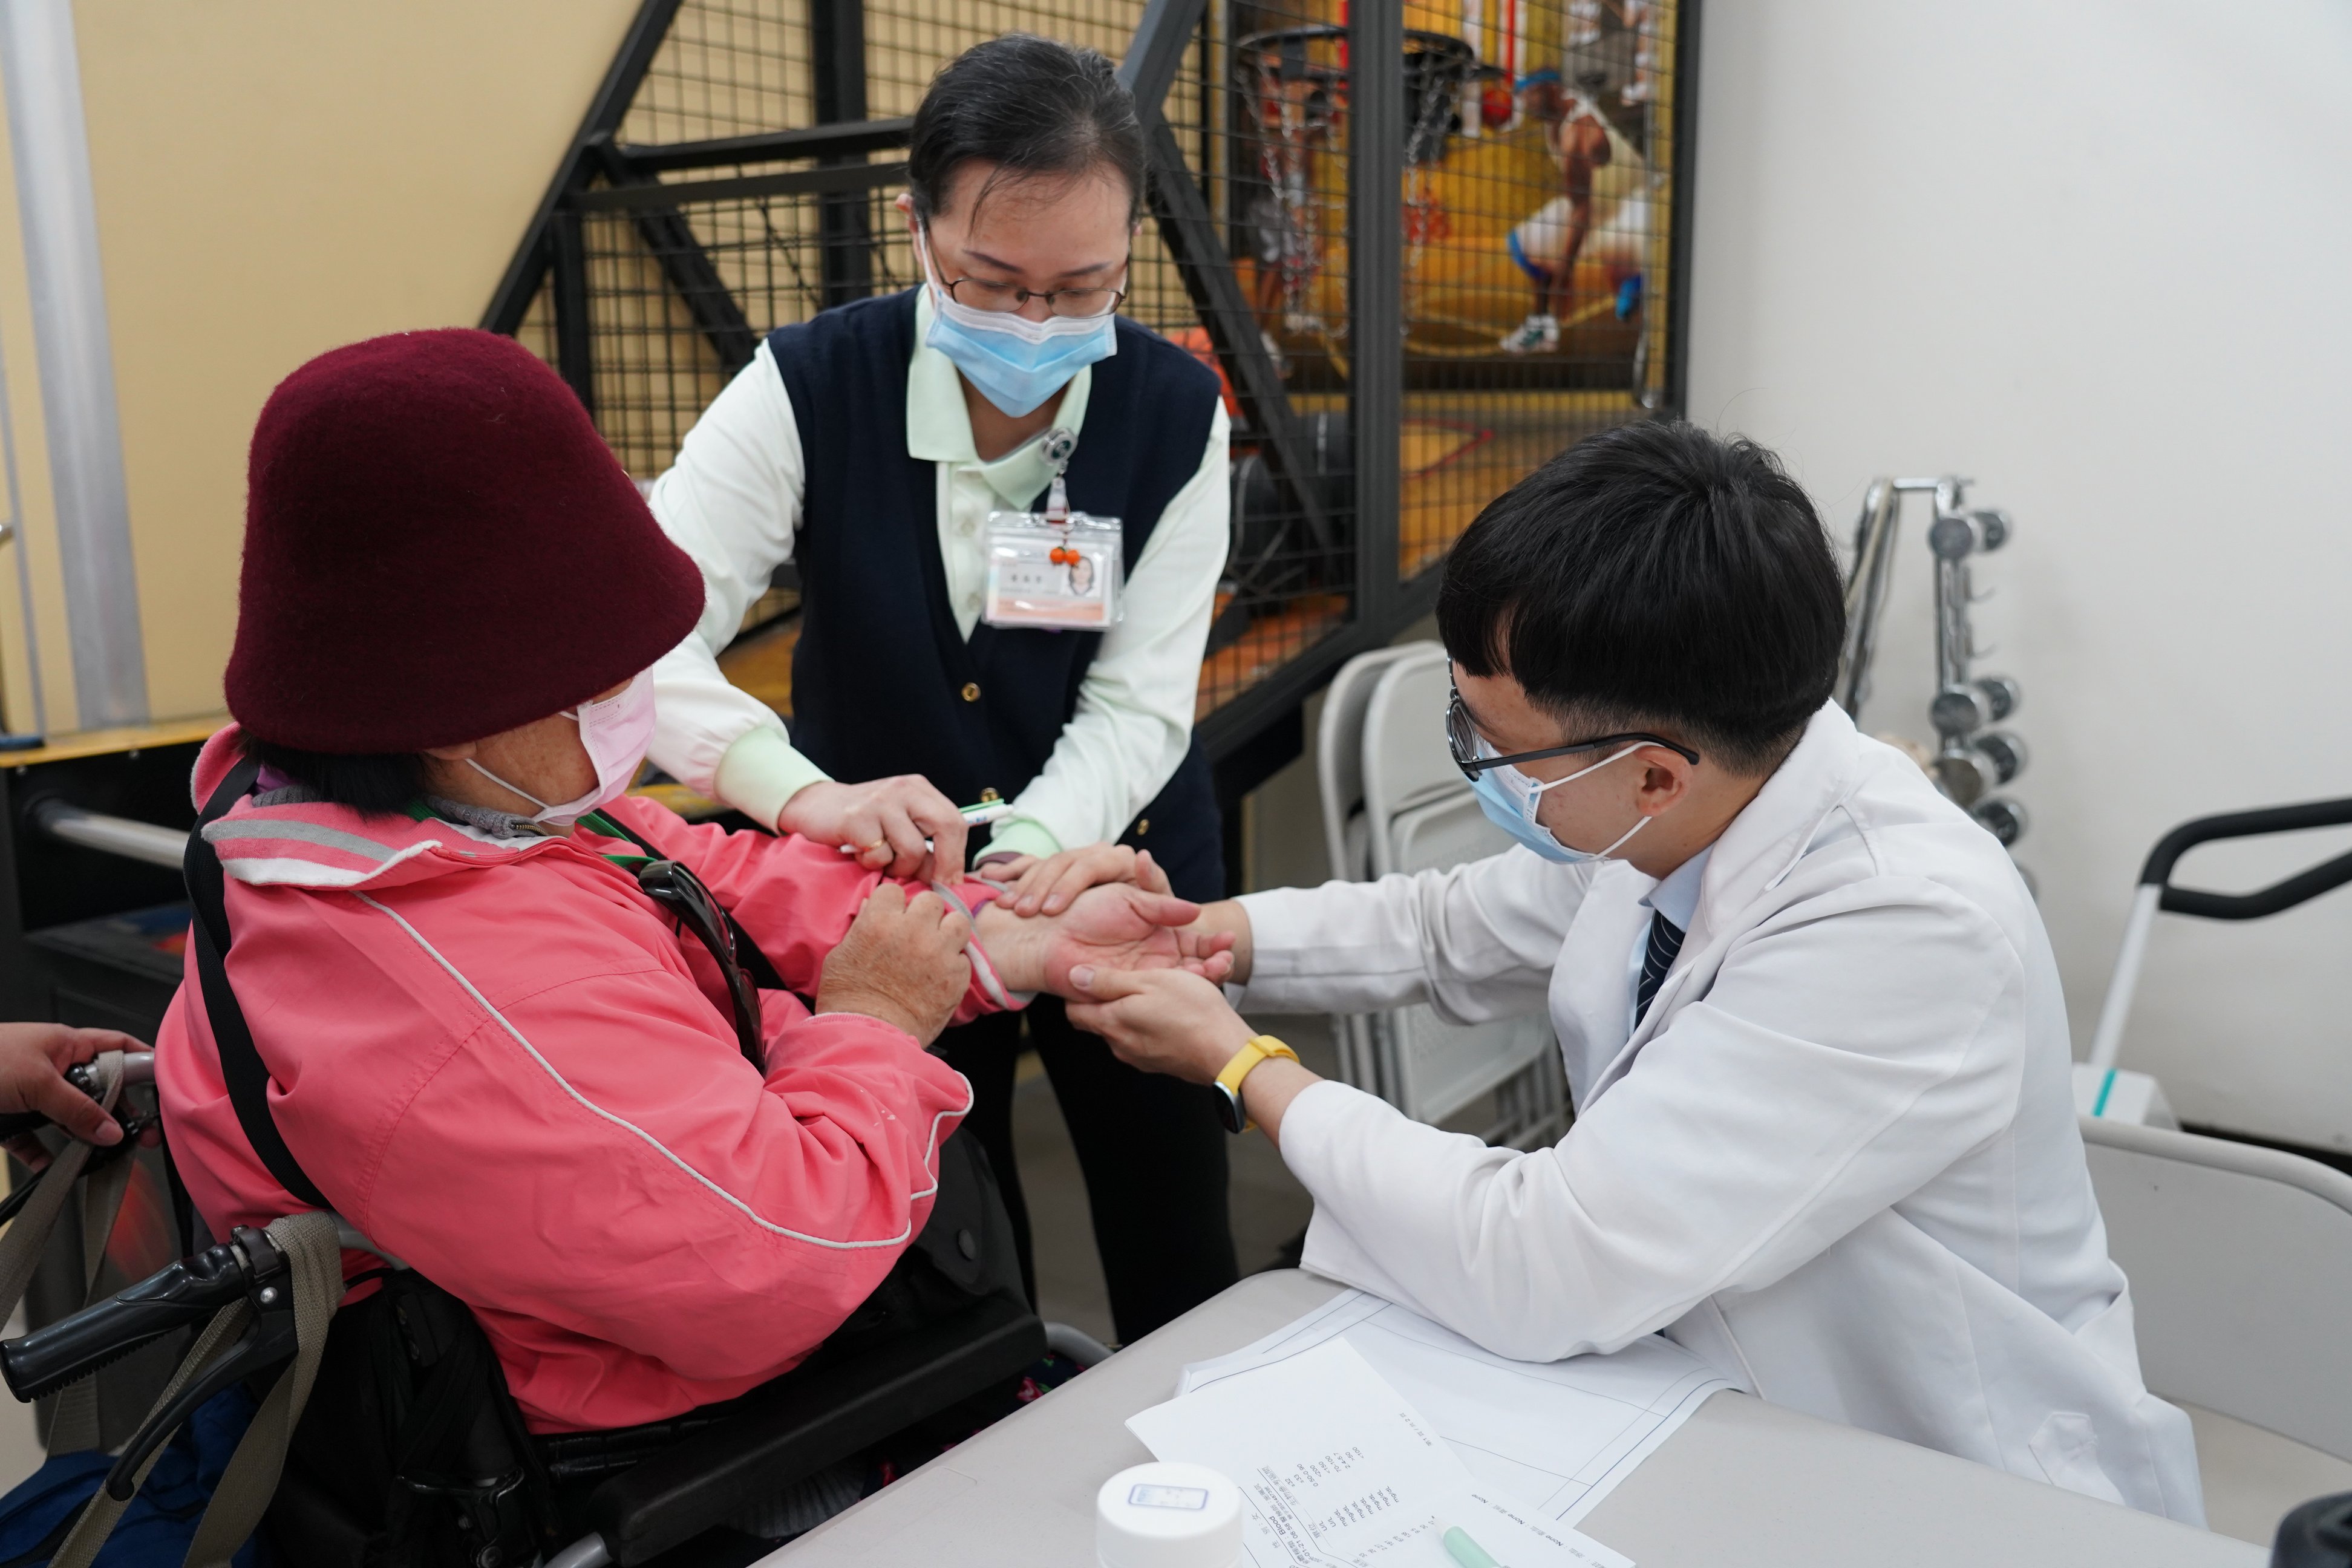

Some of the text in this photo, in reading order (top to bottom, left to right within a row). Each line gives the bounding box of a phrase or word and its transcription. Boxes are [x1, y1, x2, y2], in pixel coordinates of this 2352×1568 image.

[1345, 1452, 1355, 1461] >50
[1353, 1447, 1364, 1459] <100
[1310, 1465, 1321, 1477] <200
[1319, 1462, 1330, 1473] <150
[1325, 1456, 1341, 1472] 70-100
[1368, 1493, 1382, 1511] mg/dL
[1377, 1489, 1391, 1506] mg/dL
[1386, 1486, 1399, 1503] mg/dL
[1472, 1494, 1488, 1503] None
[1343, 1505, 1356, 1522] mg/dL
[1351, 1501, 1365, 1518] mg/dL
[1360, 1497, 1374, 1514] mg/dL
[1269, 1516, 1286, 1535] Blood
[1334, 1509, 1348, 1526] mg/dL
[1508, 1514, 1525, 1524] None
[1319, 1521, 1327, 1531] U/L
[1546, 1535, 1563, 1546] None
